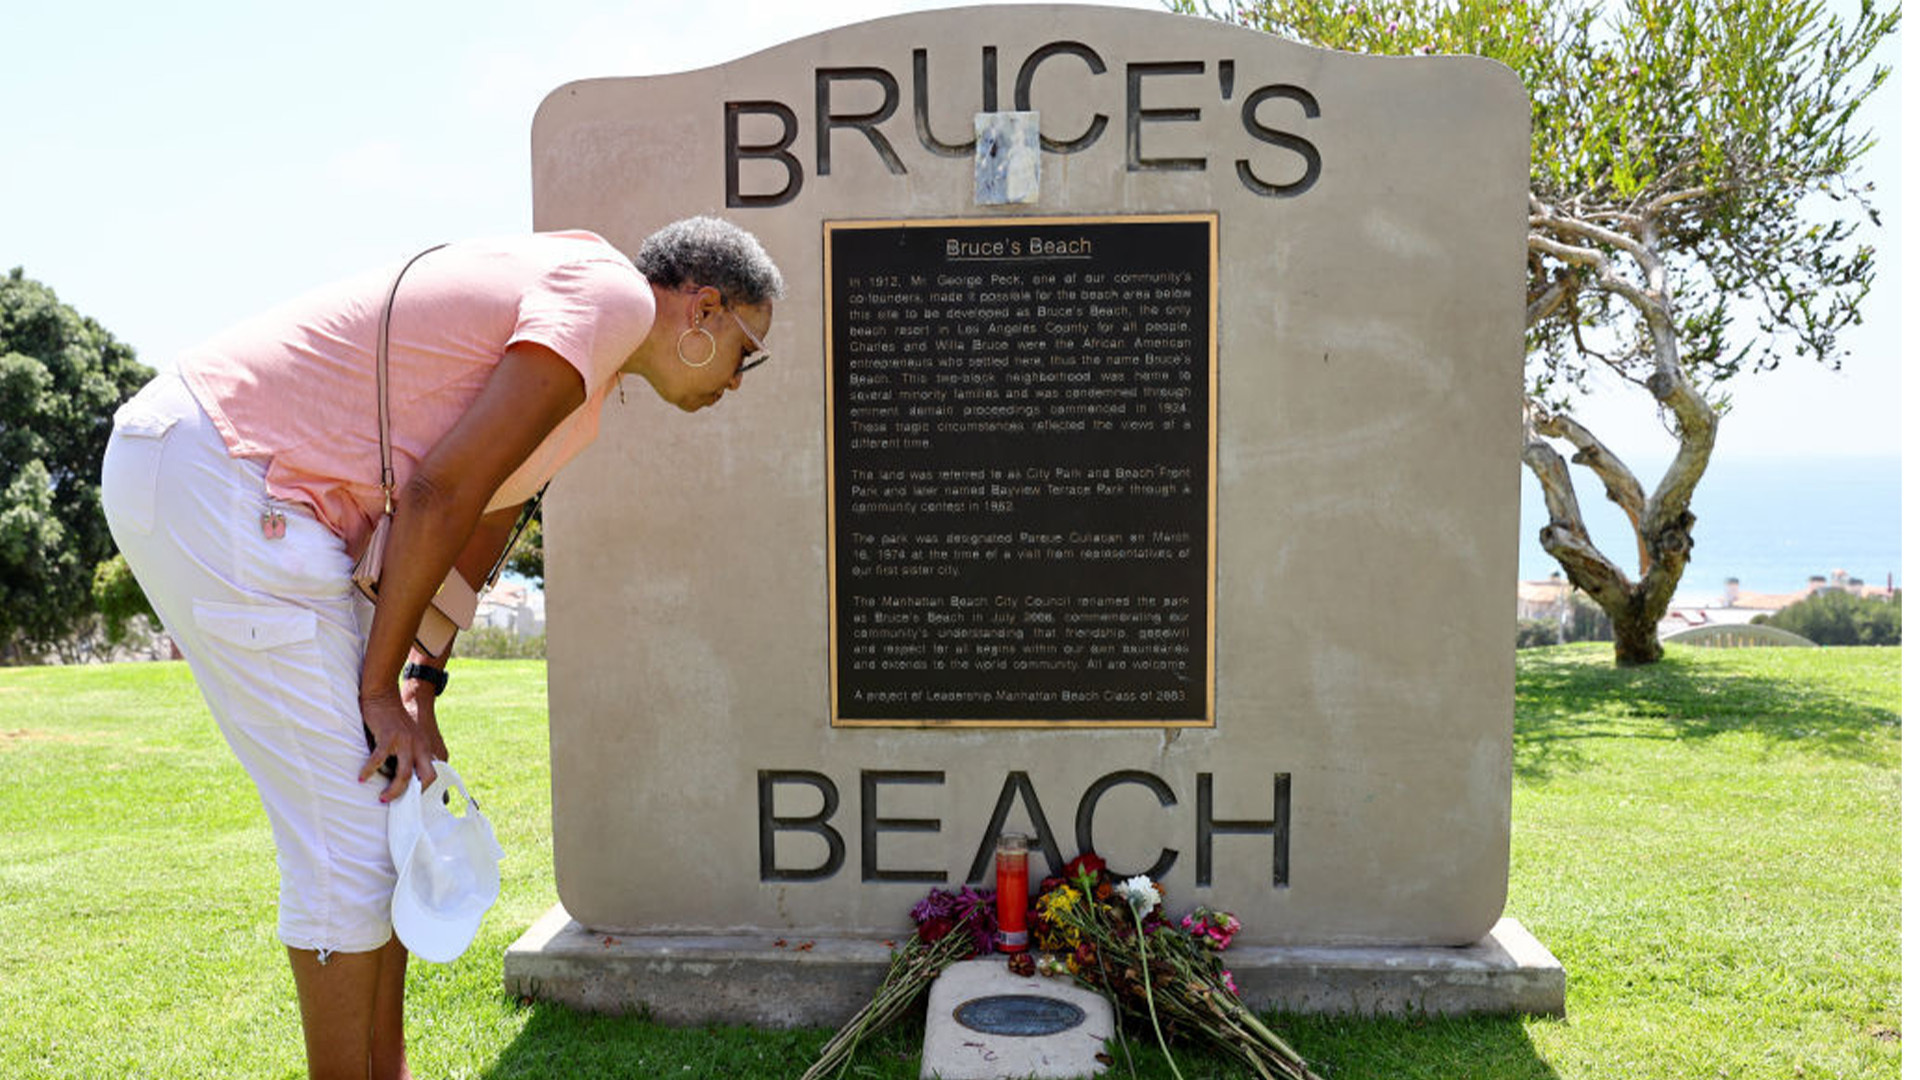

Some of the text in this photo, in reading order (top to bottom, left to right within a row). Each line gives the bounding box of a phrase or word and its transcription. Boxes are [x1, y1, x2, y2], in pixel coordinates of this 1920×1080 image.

[723, 40, 1323, 209] BRUCE'S
[946, 235, 1093, 256] Bruce's Beach
[757, 769, 1291, 888] BEACH
